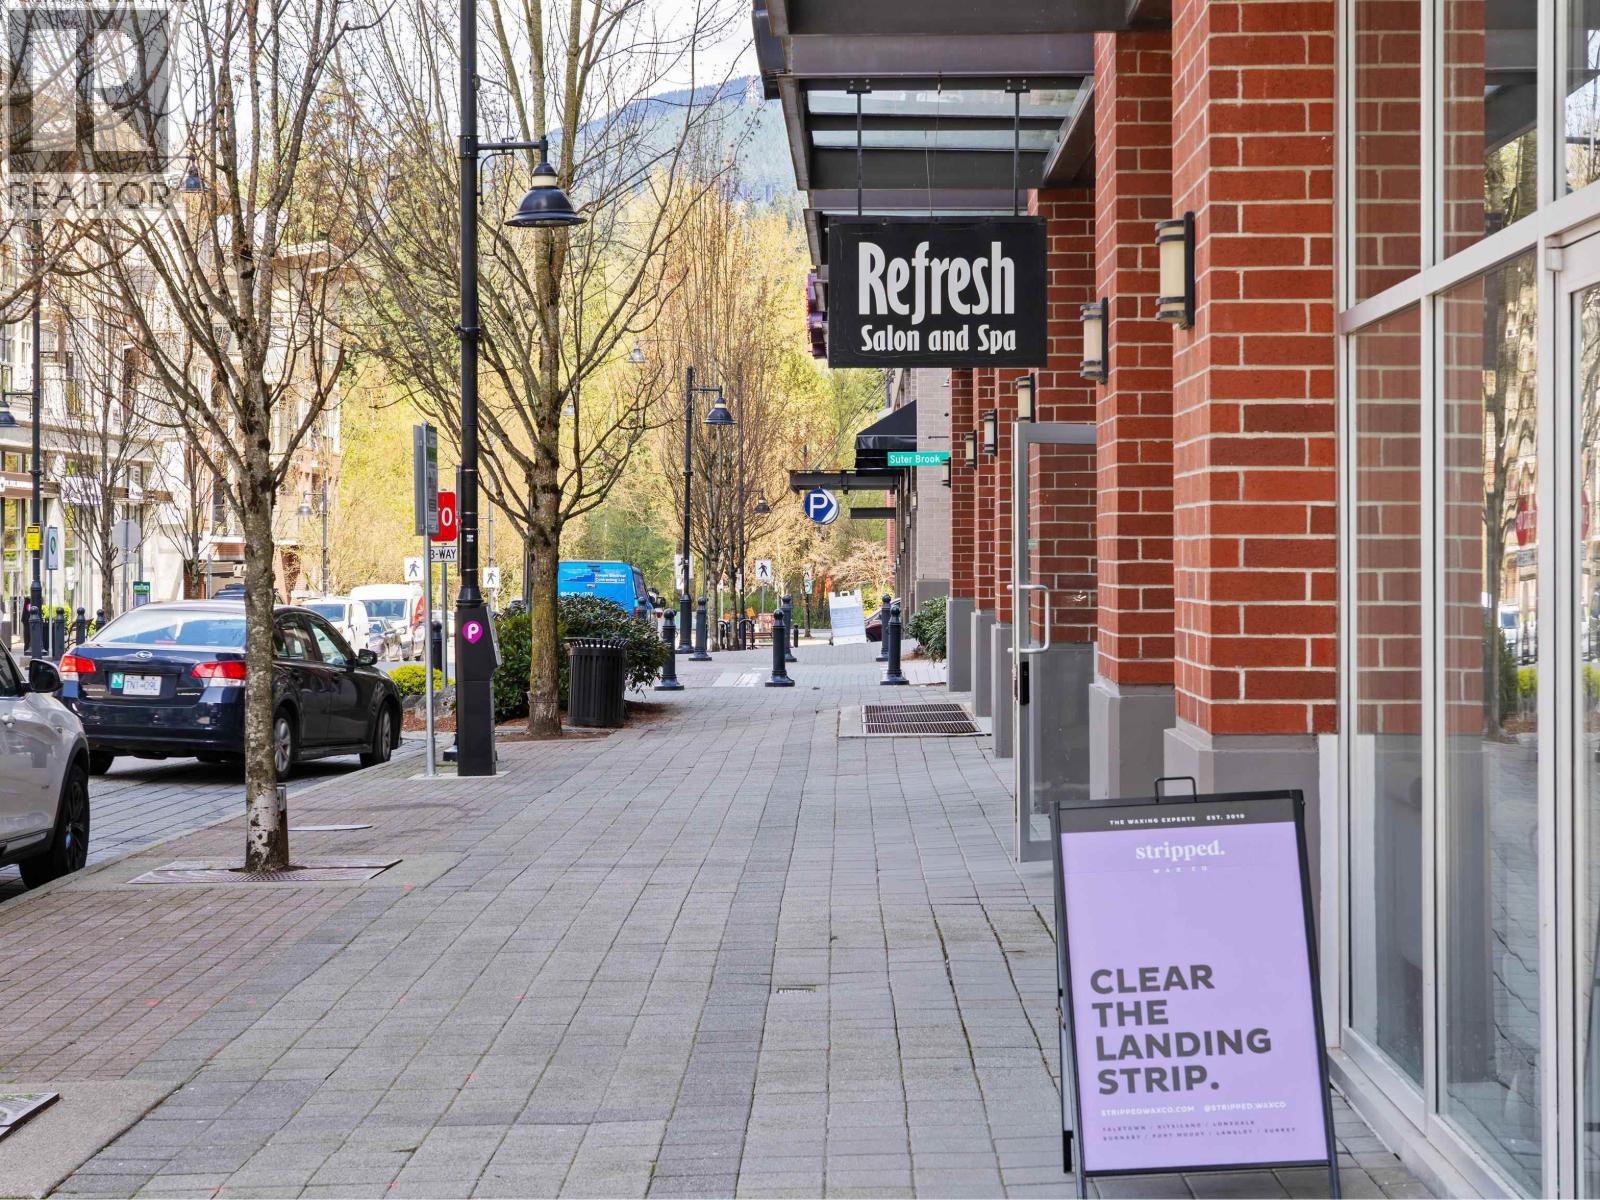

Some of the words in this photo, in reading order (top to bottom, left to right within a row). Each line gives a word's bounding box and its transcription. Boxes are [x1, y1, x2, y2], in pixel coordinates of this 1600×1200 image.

[858, 241, 1015, 325] Refresh
[861, 324, 920, 351] Salon
[928, 325, 969, 351] and
[977, 324, 1016, 354] Spa
[889, 454, 912, 464] Suter
[915, 454, 941, 464] Brook
[809, 493, 829, 518] P
[1127, 817, 1159, 825] WAXING
[1135, 839, 1226, 862] stripped.
[1090, 964, 1215, 995] CLEAR
[1091, 999, 1169, 1028] THE
[1096, 1028, 1272, 1062] LANDING
[1098, 1064, 1220, 1095] STRIP.
